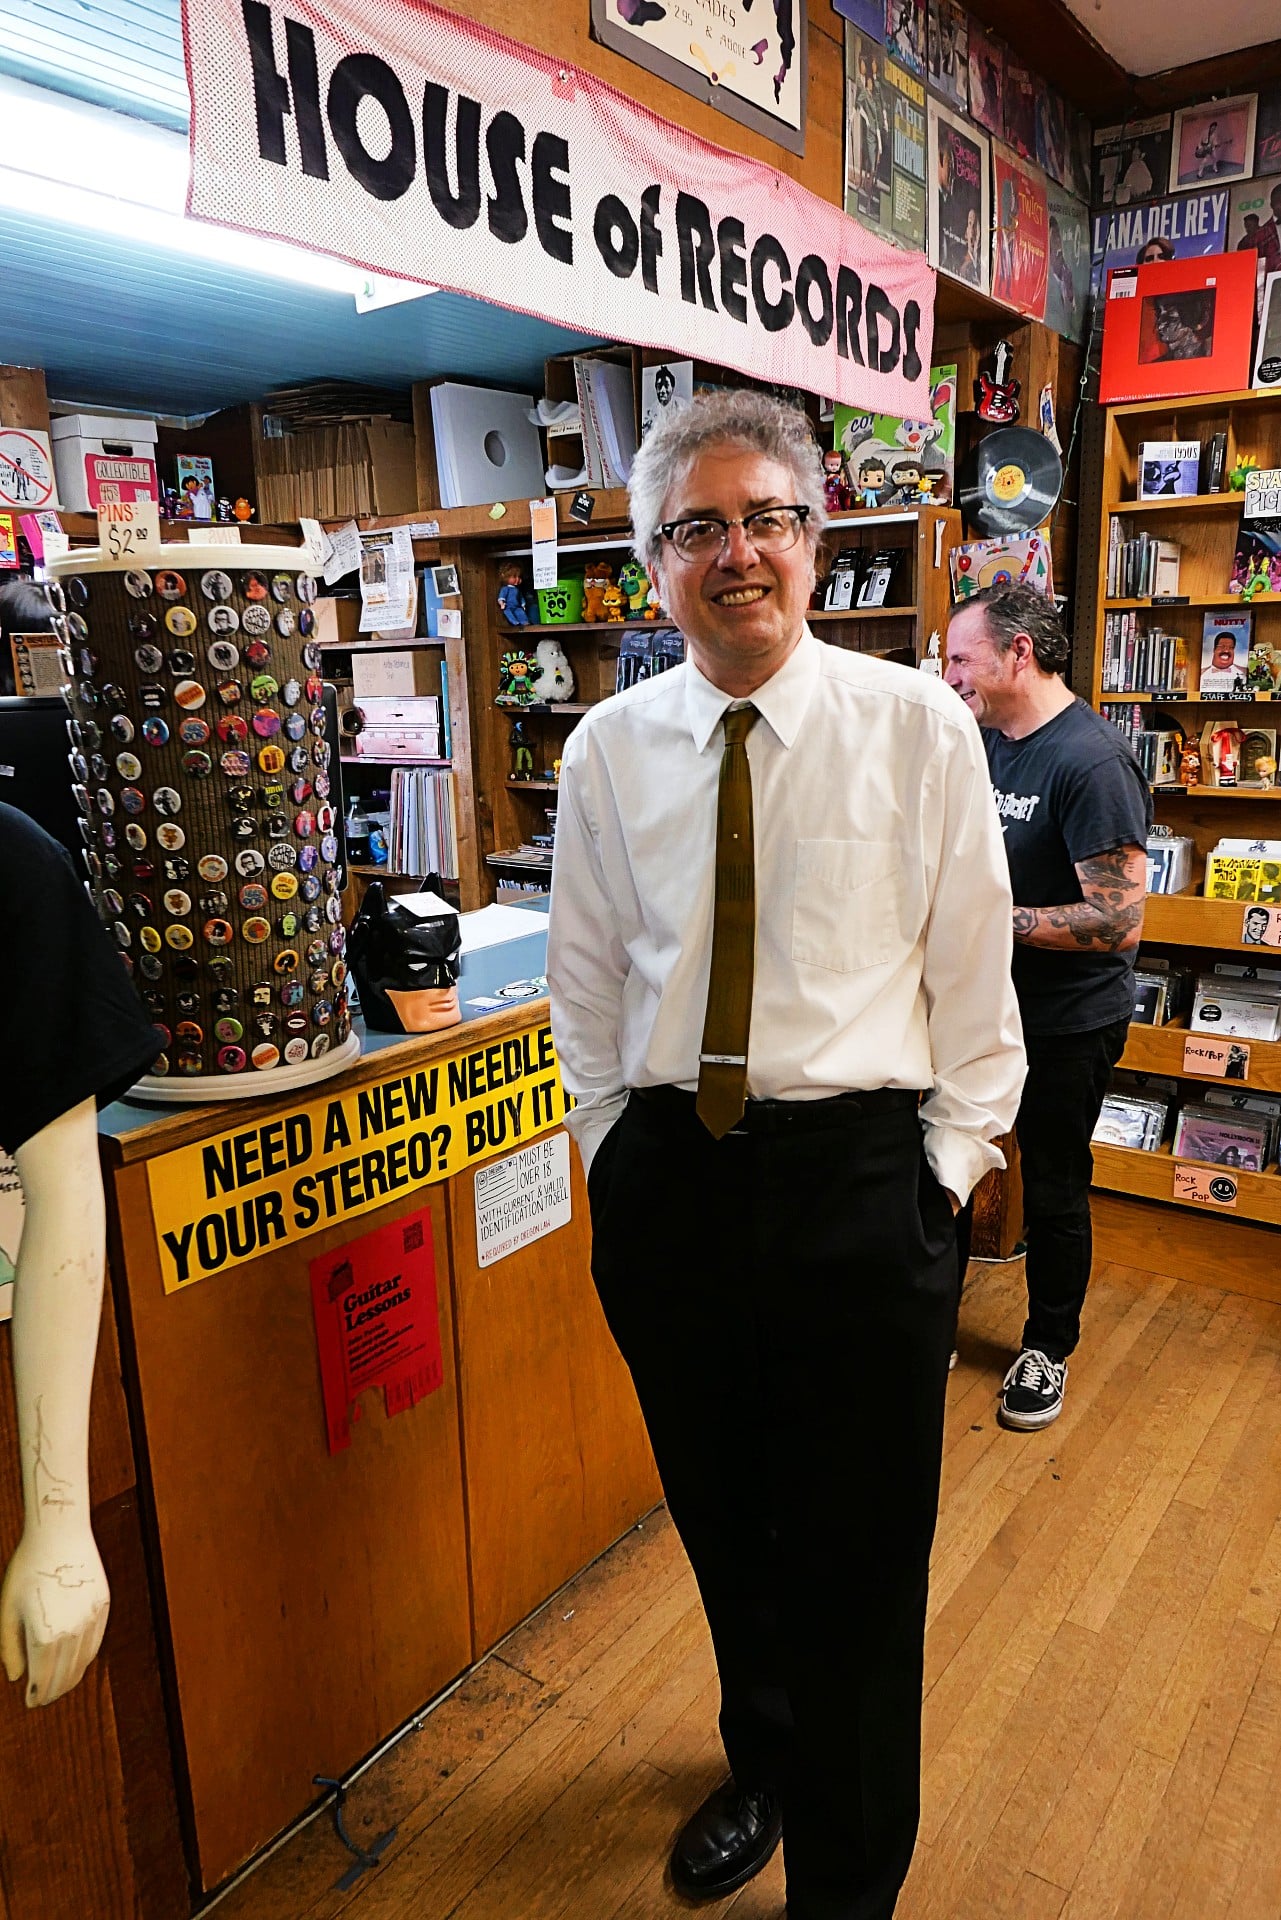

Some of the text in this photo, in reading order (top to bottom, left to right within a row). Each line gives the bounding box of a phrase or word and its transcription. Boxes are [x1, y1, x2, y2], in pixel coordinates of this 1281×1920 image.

[242, 0, 574, 265] HOUSE
[675, 189, 924, 383] RECORDS
[1019, 192, 1043, 226] TWIST
[1094, 209, 1145, 254] LANA
[1147, 201, 1181, 242] DEL
[1184, 192, 1226, 238] REY
[96, 461, 150, 481] COLLECTIBLE
[1214, 618, 1247, 627] NUTTY
[202, 1027, 555, 1200] NEED A NEW NEEDLE
[519, 1139, 555, 1170] MUST BE
[519, 1160, 552, 1189] OVER 18
[162, 1078, 559, 1283] YOUR STEREO? BUY IT
[1175, 1173, 1197, 1184] Rock
[478, 1176, 565, 1225] WITH CURRENT & VALID
[480, 1199, 544, 1242] IDENTIFICATION
[540, 1219, 552, 1233] LAW
[343, 1273, 402, 1314] Guitar
[345, 1287, 412, 1332] Lessons
